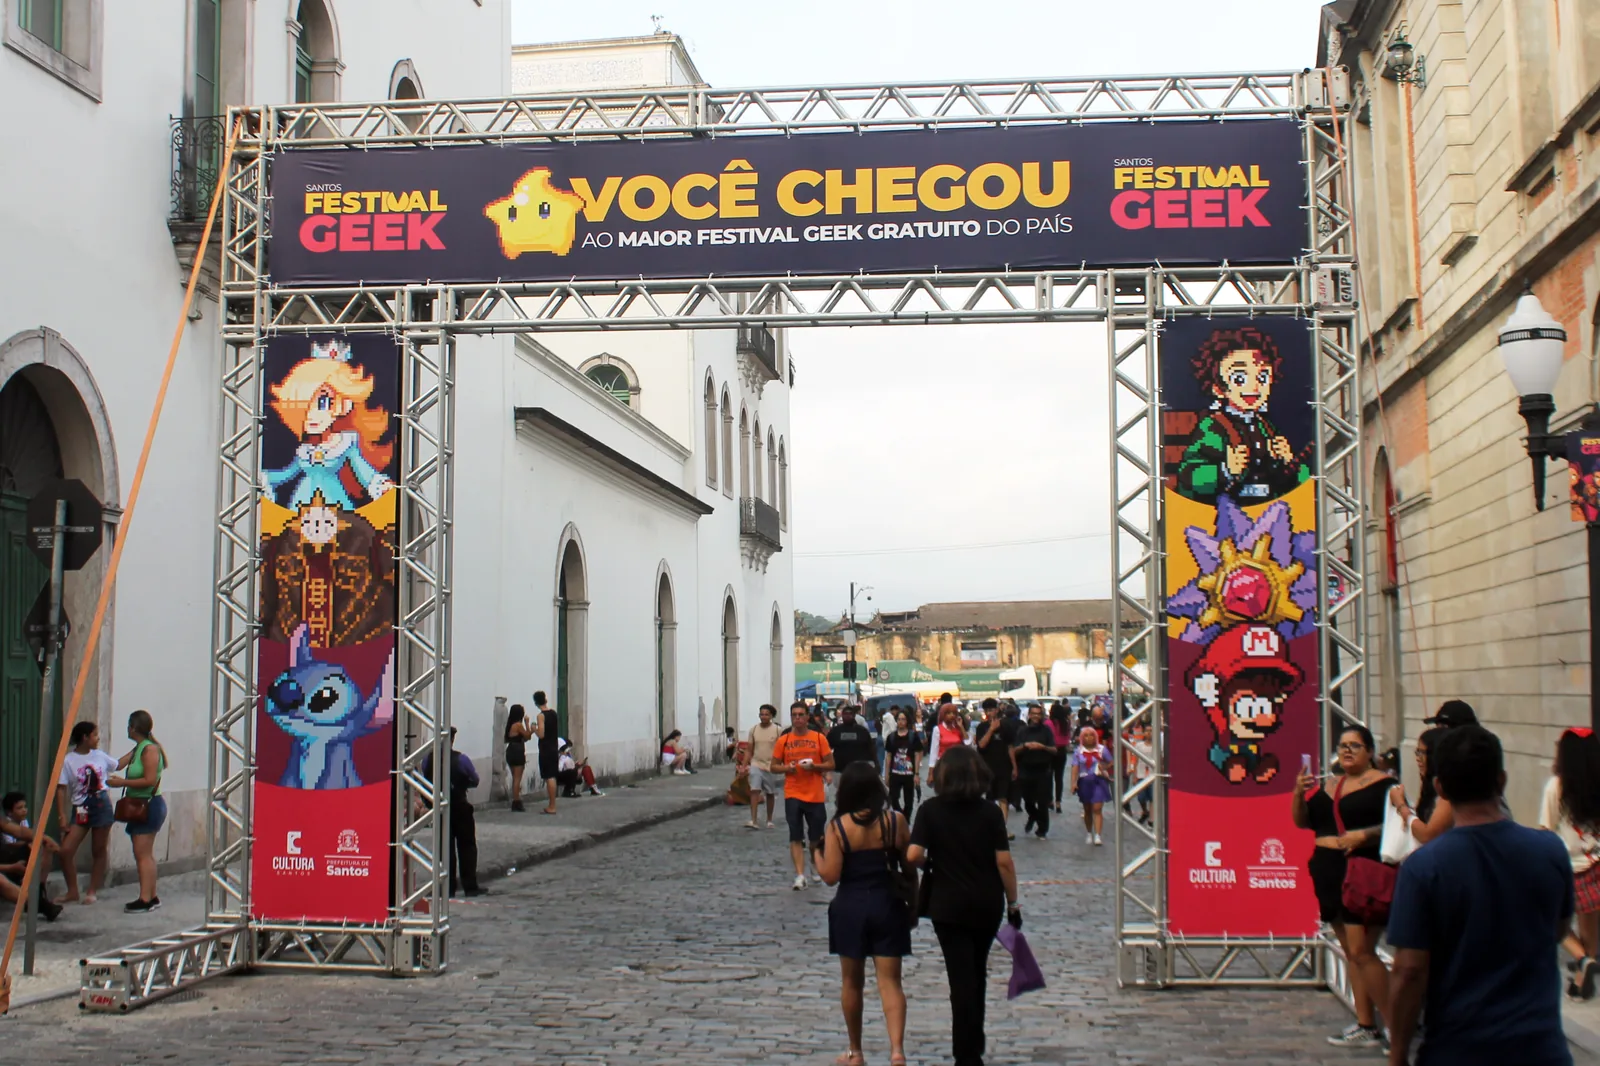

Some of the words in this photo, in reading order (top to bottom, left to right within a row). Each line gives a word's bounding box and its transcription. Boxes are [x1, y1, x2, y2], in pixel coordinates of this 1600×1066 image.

[1113, 158, 1154, 167] SANTOS
[1114, 164, 1270, 190] FESTIVAL
[305, 183, 342, 193] SANTOS
[569, 159, 760, 223] VOCÊ
[777, 160, 1071, 217] CHEGOU
[304, 190, 448, 214] FESTIVAL
[1110, 187, 1271, 230] GEEK
[298, 211, 447, 253] GEEK
[582, 232, 613, 249] AO
[618, 229, 692, 248] MAIOR
[696, 226, 799, 246] FESTIVAL
[803, 223, 863, 243] GEEK
[867, 219, 982, 241] GRATUITO
[986, 218, 1021, 236] DO
[1026, 213, 1073, 235] PAÍS
[272, 856, 315, 871] CULTURA
[326, 865, 370, 877] Santos
[1189, 869, 1237, 883] CULTURA
[1248, 877, 1297, 889] Santos
